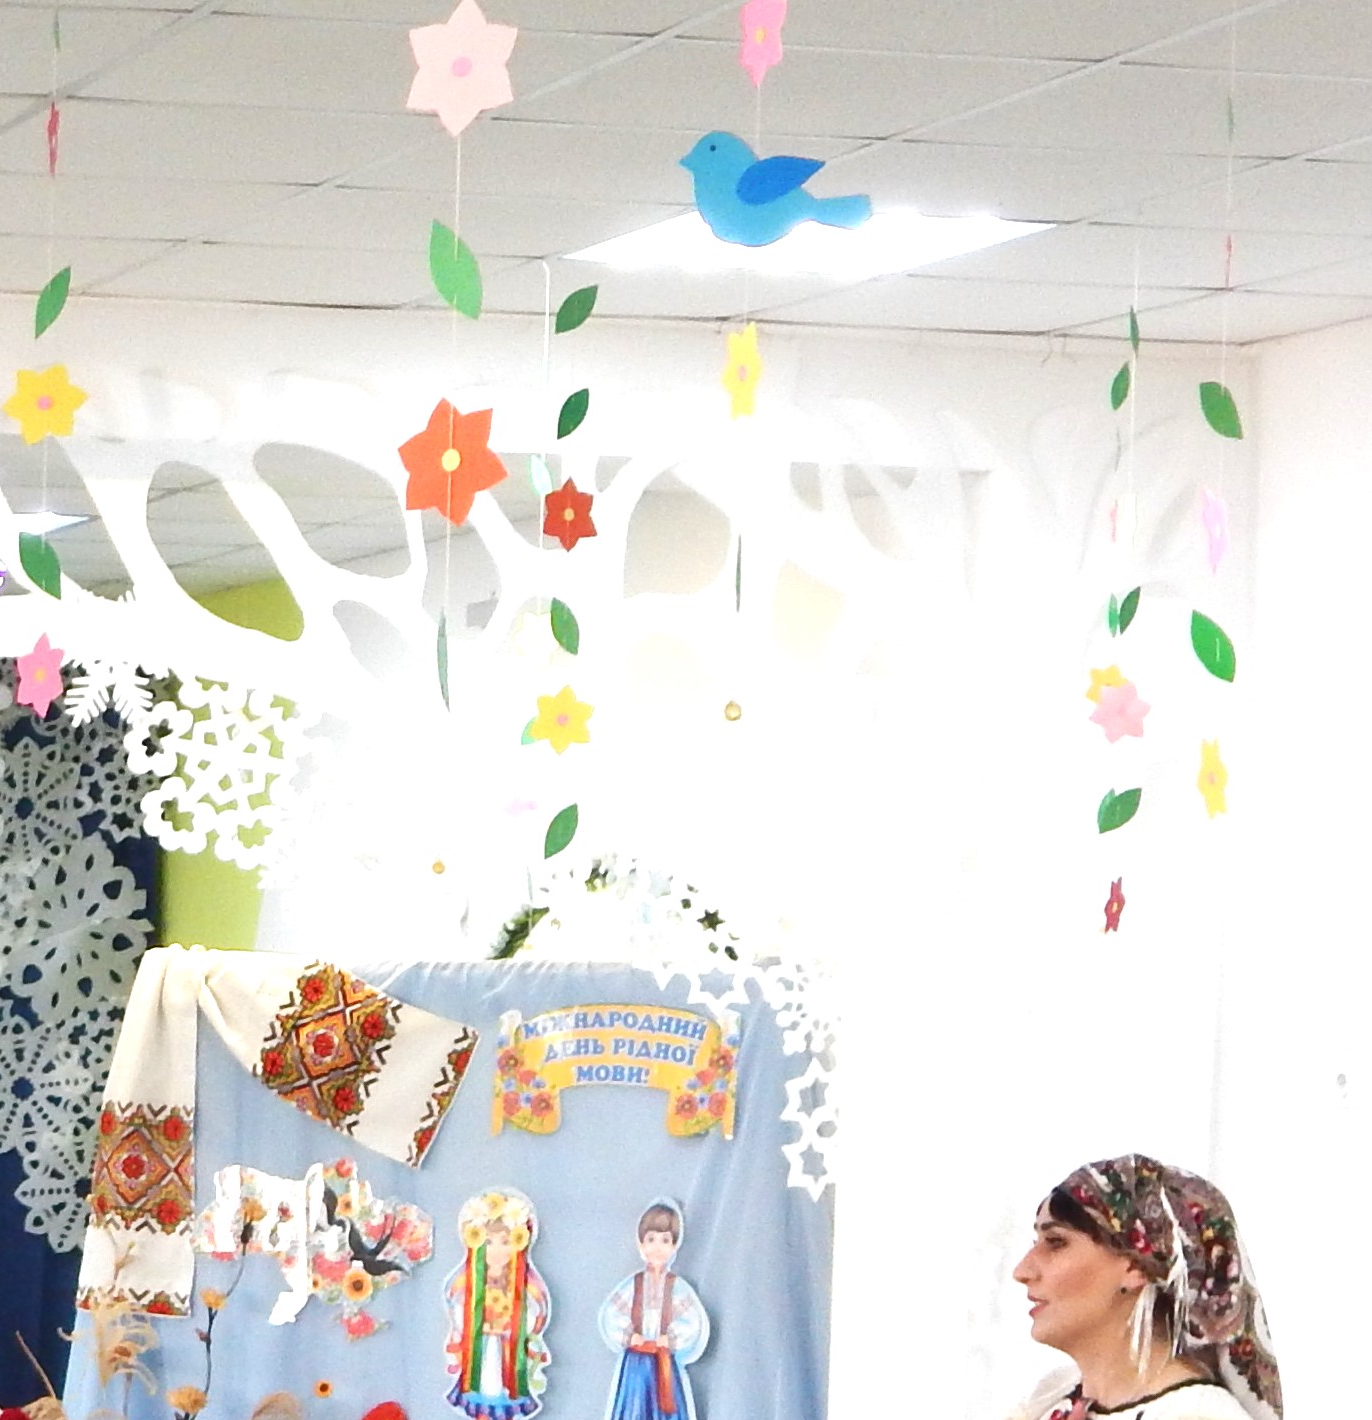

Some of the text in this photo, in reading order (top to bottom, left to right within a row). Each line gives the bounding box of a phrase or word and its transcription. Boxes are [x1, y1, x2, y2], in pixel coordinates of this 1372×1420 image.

[522, 1010, 708, 1040] МНАРОДНИЙ
[544, 1038, 698, 1066] ДЕНЬ РІДНОЇ
[576, 1065, 650, 1084] МОВИ!
